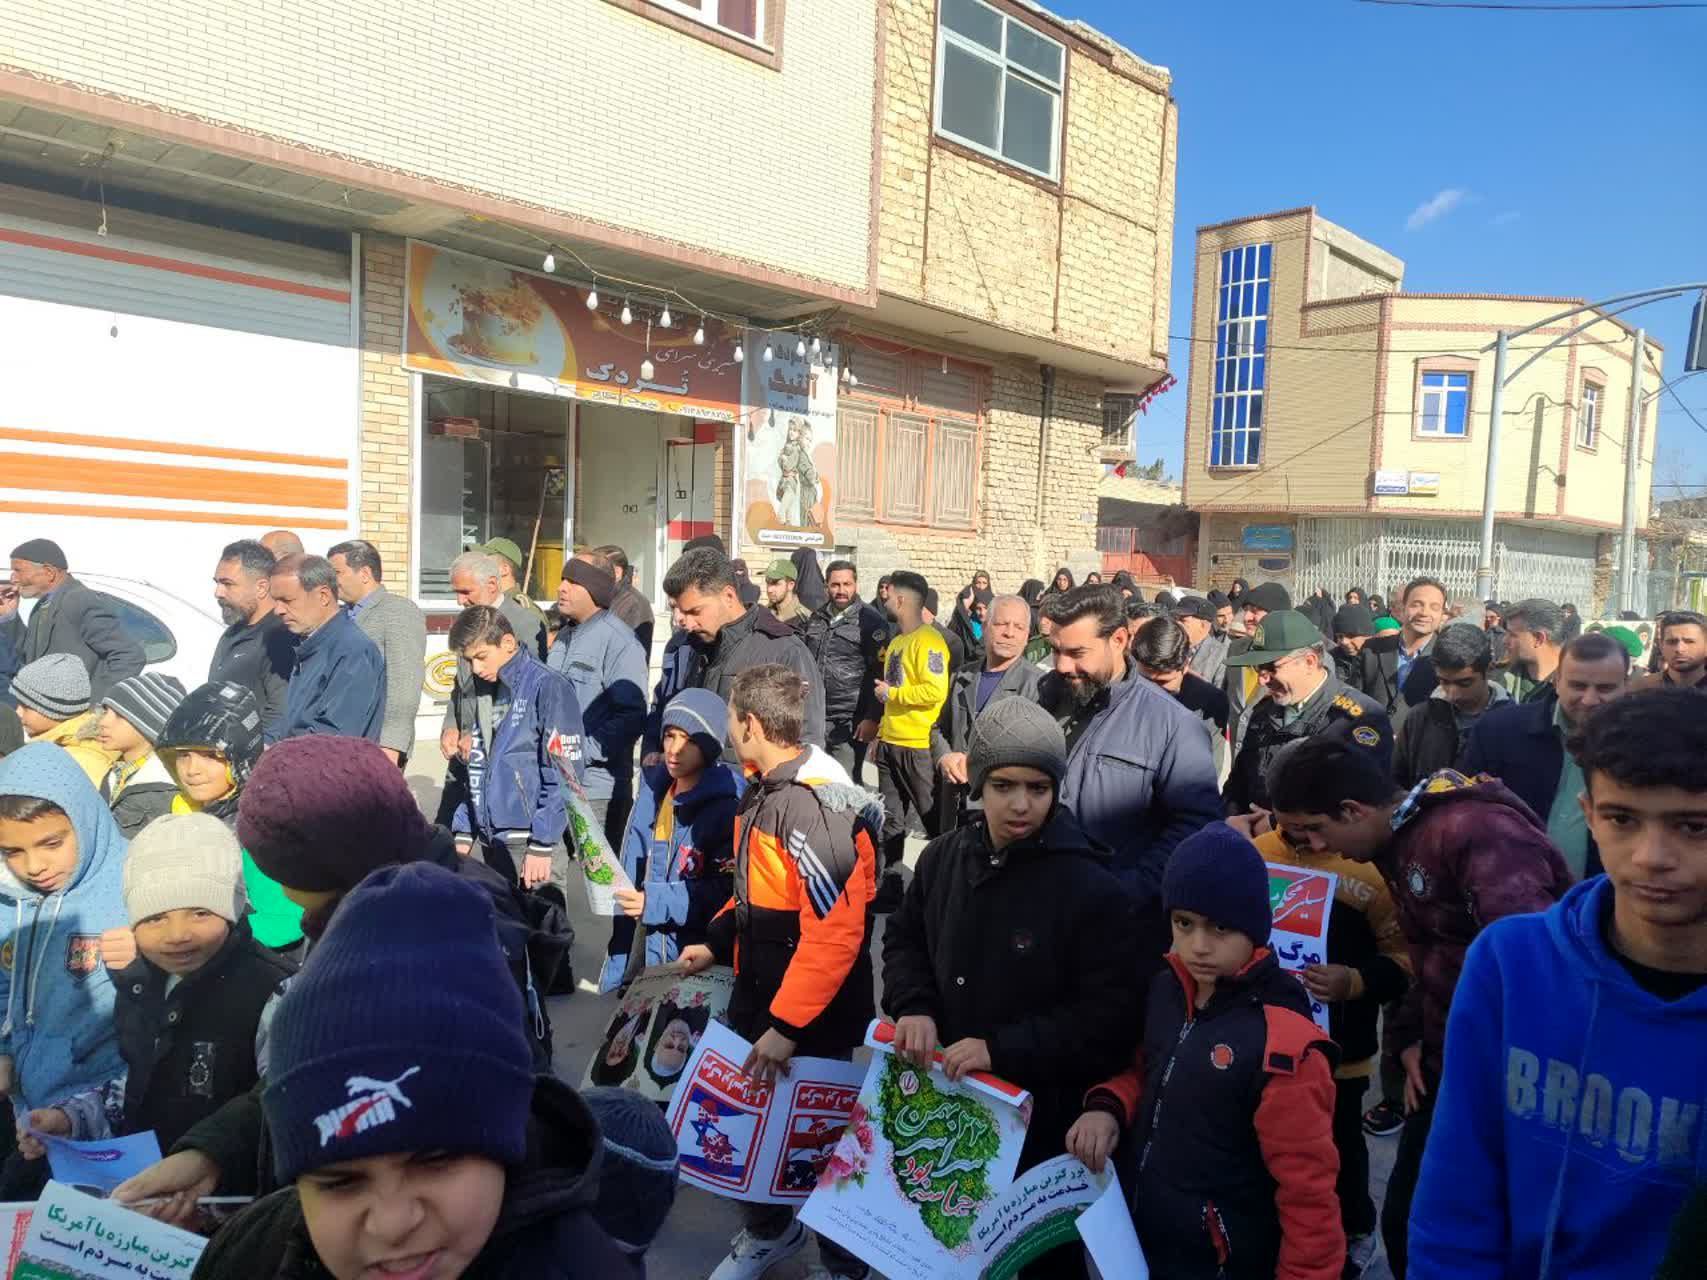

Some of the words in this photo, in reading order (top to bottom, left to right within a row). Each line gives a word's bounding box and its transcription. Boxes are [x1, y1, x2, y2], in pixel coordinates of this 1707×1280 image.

[1279, 940, 1321, 970] مرگ
[895, 1102, 961, 1137] بهمن
[1010, 1183, 1038, 1208] مبارزه
[1047, 1180, 1089, 1199] خدمت
[47, 1203, 95, 1233] آمریکا
[95, 1218, 106, 1241] با
[1007, 1204, 1037, 1232] مردم
[39, 1227, 84, 1253] است
[107, 1231, 151, 1254] مبارزه
[983, 1222, 1008, 1253] است
[83, 1246, 132, 1271] مردم
[134, 1263, 148, 1276] به
